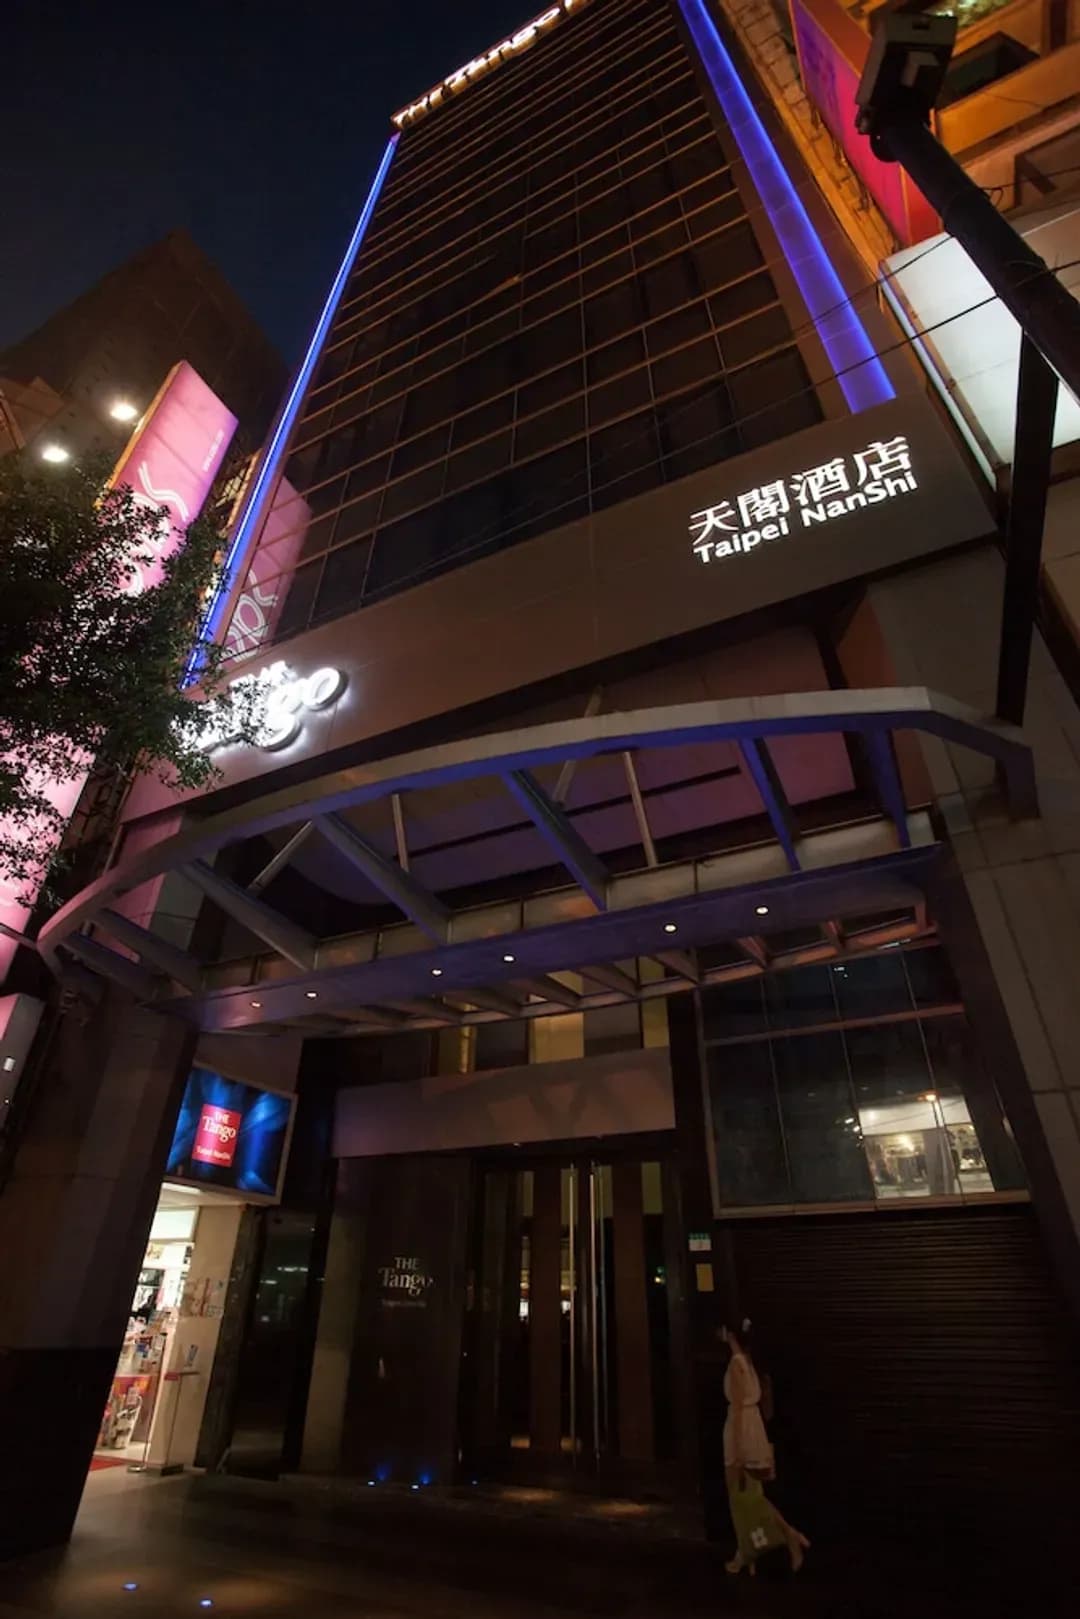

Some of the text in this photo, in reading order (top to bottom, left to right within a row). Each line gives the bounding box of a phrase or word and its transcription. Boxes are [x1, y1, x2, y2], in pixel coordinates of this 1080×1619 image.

[688, 436, 912, 546] 天閣酒店
[693, 472, 918, 563] Taipei NanShi
[202, 1115, 237, 1143] Tango
[394, 1256, 420, 1271] THE
[377, 1266, 435, 1297] Tango
